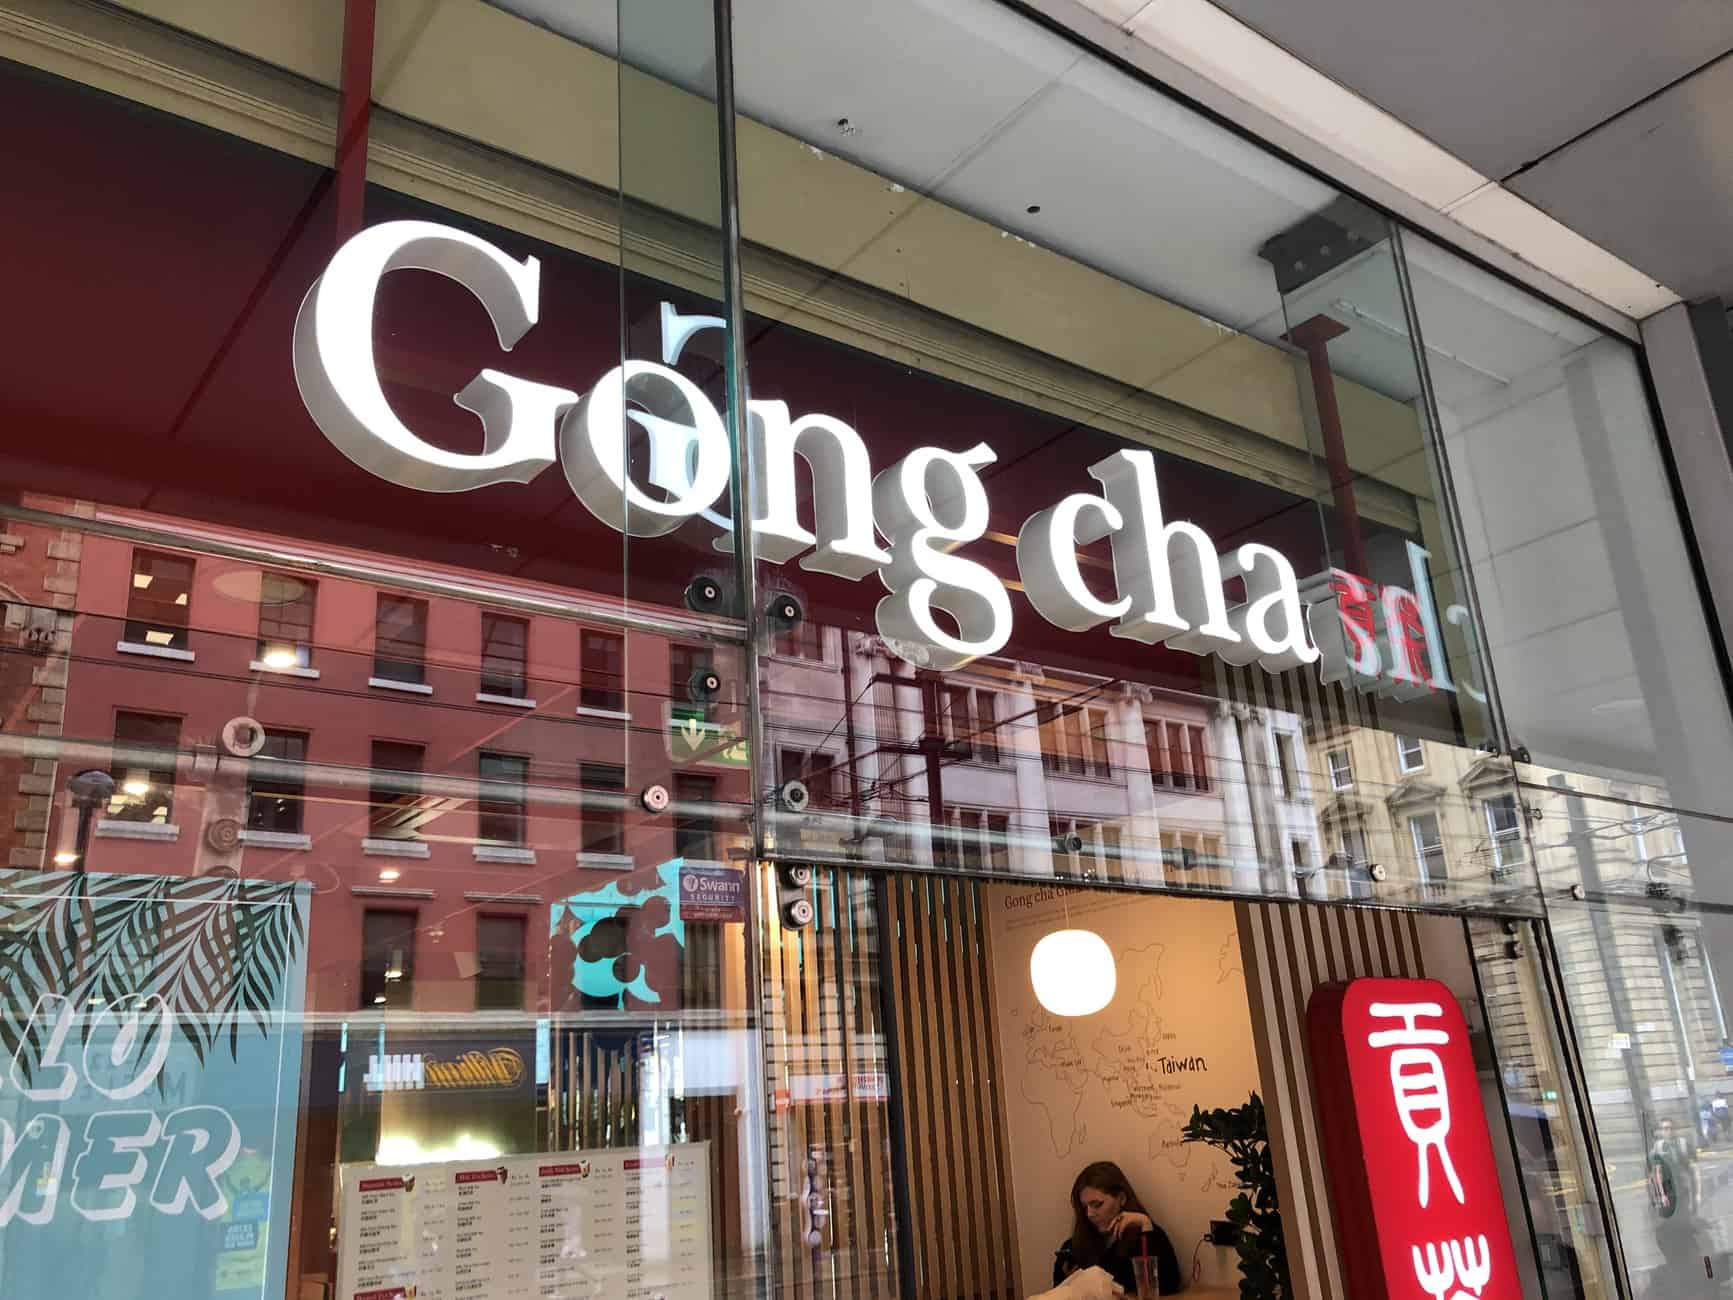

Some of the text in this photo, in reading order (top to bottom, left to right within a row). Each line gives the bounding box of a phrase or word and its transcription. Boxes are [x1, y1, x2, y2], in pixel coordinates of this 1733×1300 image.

[302, 219, 1014, 664] Gong
[1032, 448, 1320, 668] cha
[699, 876, 740, 895] Swann
[1004, 893, 1033, 910] Gong
[0, 992, 174, 1101] LO
[1157, 1056, 1208, 1075] Taiwan
